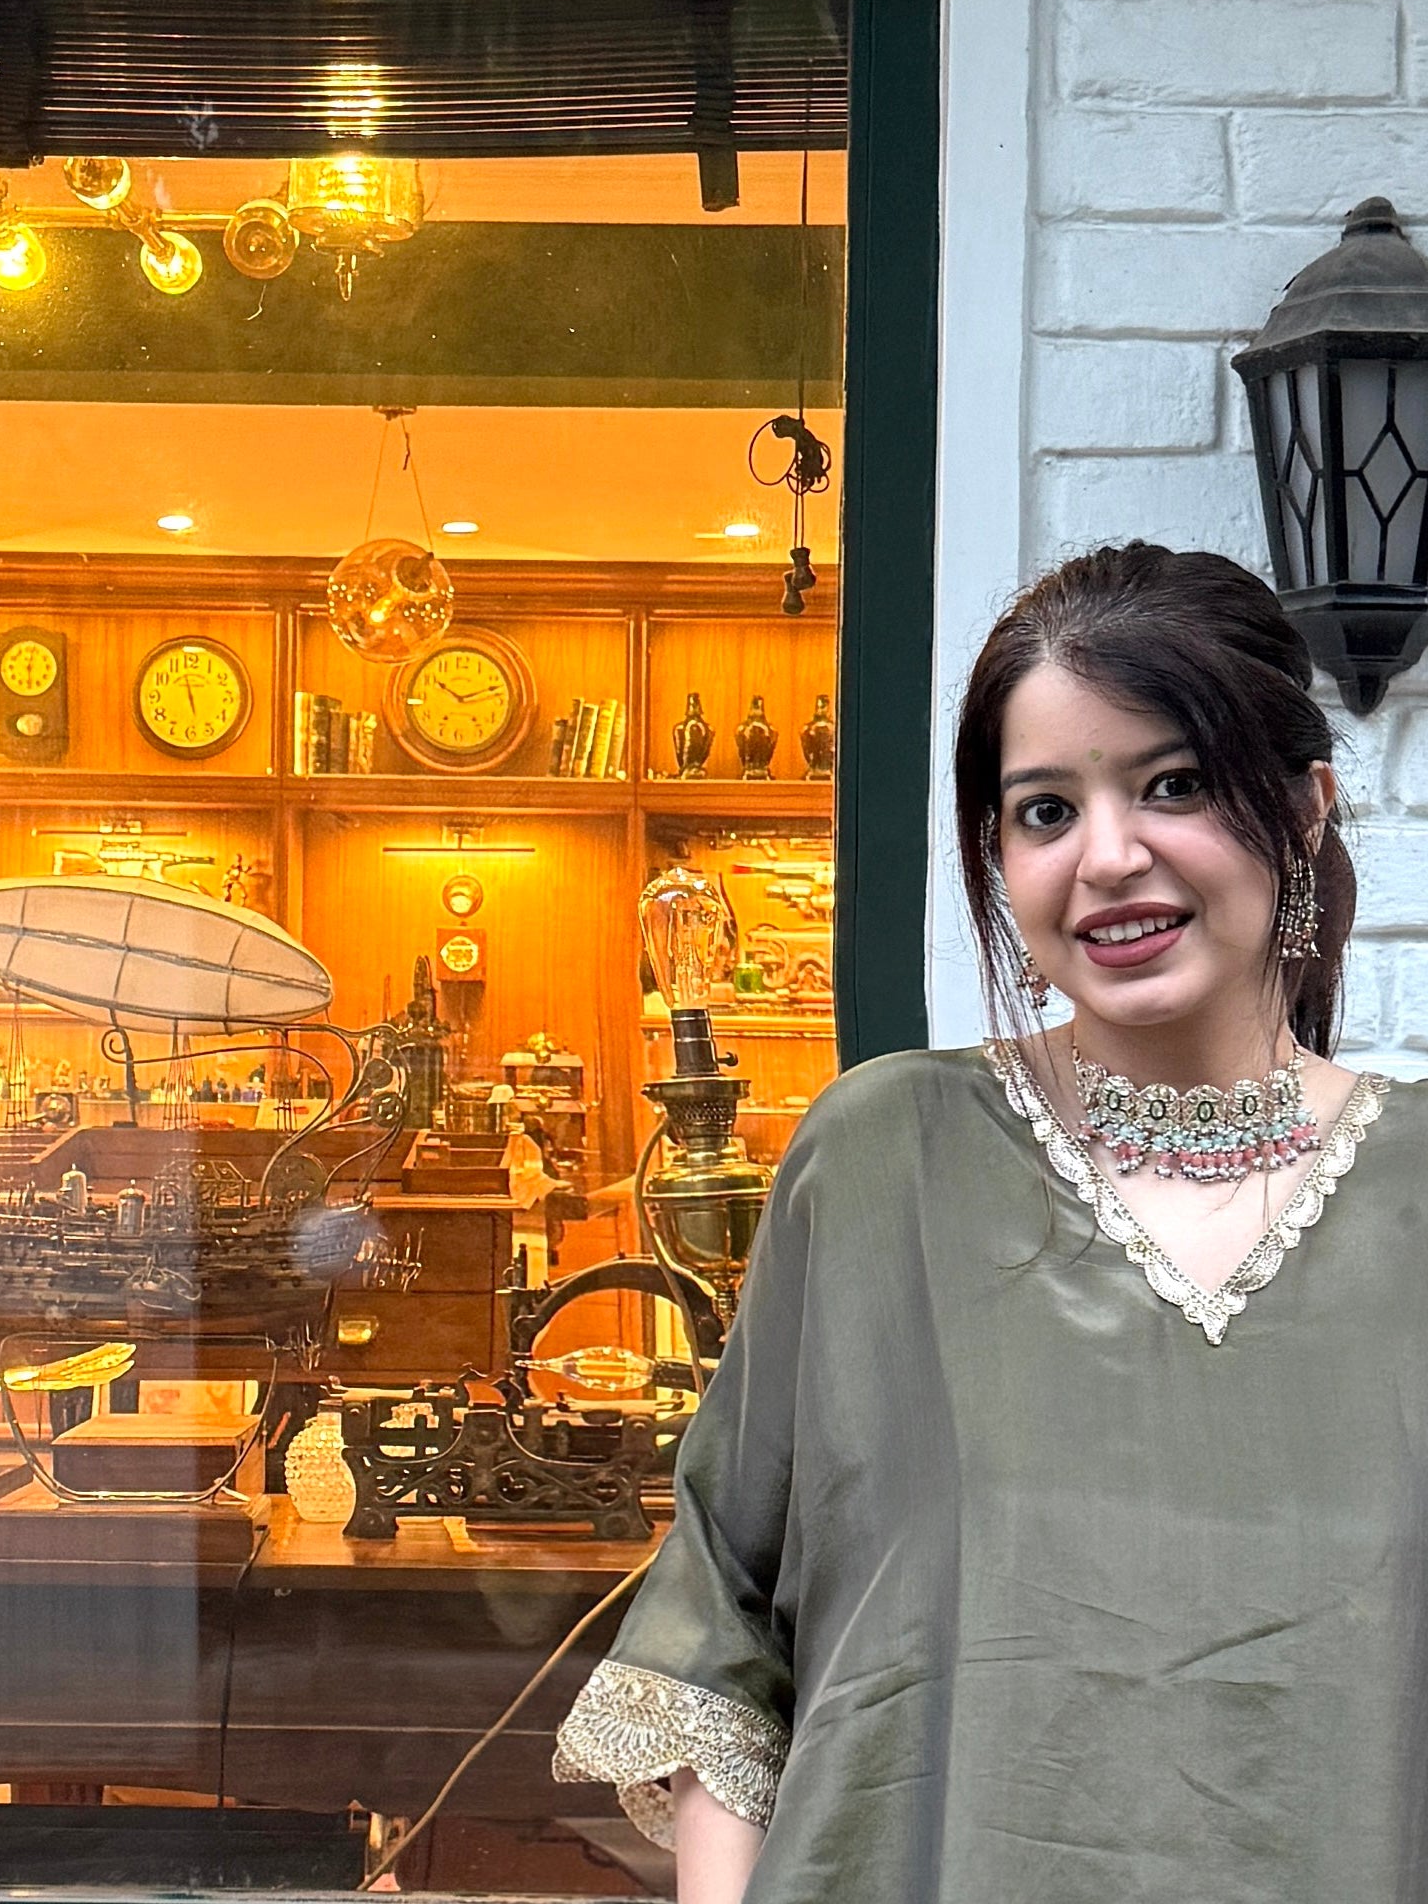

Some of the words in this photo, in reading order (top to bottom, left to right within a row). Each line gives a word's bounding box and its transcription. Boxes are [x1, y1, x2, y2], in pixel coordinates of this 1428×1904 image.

[169, 658, 179, 673] 11
[183, 654, 199, 669] 12
[155, 672, 170, 686] 10
[217, 672, 228, 687] 2
[154, 707, 167, 721] 8
[184, 726, 197, 741] 6
